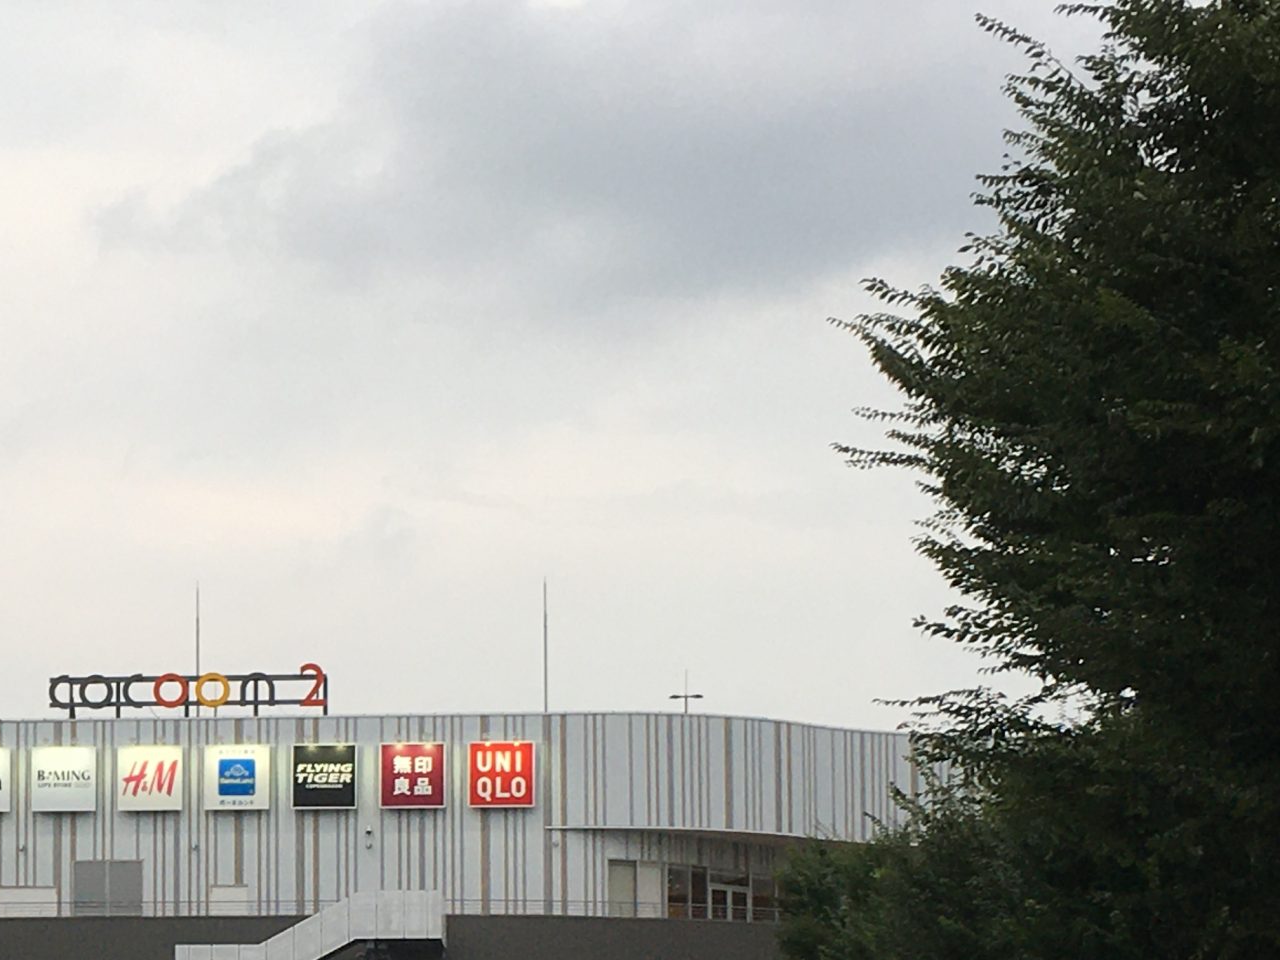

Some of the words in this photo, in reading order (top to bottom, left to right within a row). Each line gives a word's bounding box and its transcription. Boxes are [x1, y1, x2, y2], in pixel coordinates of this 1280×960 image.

[296, 763, 353, 773] FLYING
[393, 755, 432, 774] 無印
[476, 751, 521, 773] UNI
[122, 759, 178, 797] H&M
[295, 773, 352, 784] TIGER
[393, 776, 432, 796] 良品
[477, 777, 526, 801] QLO
